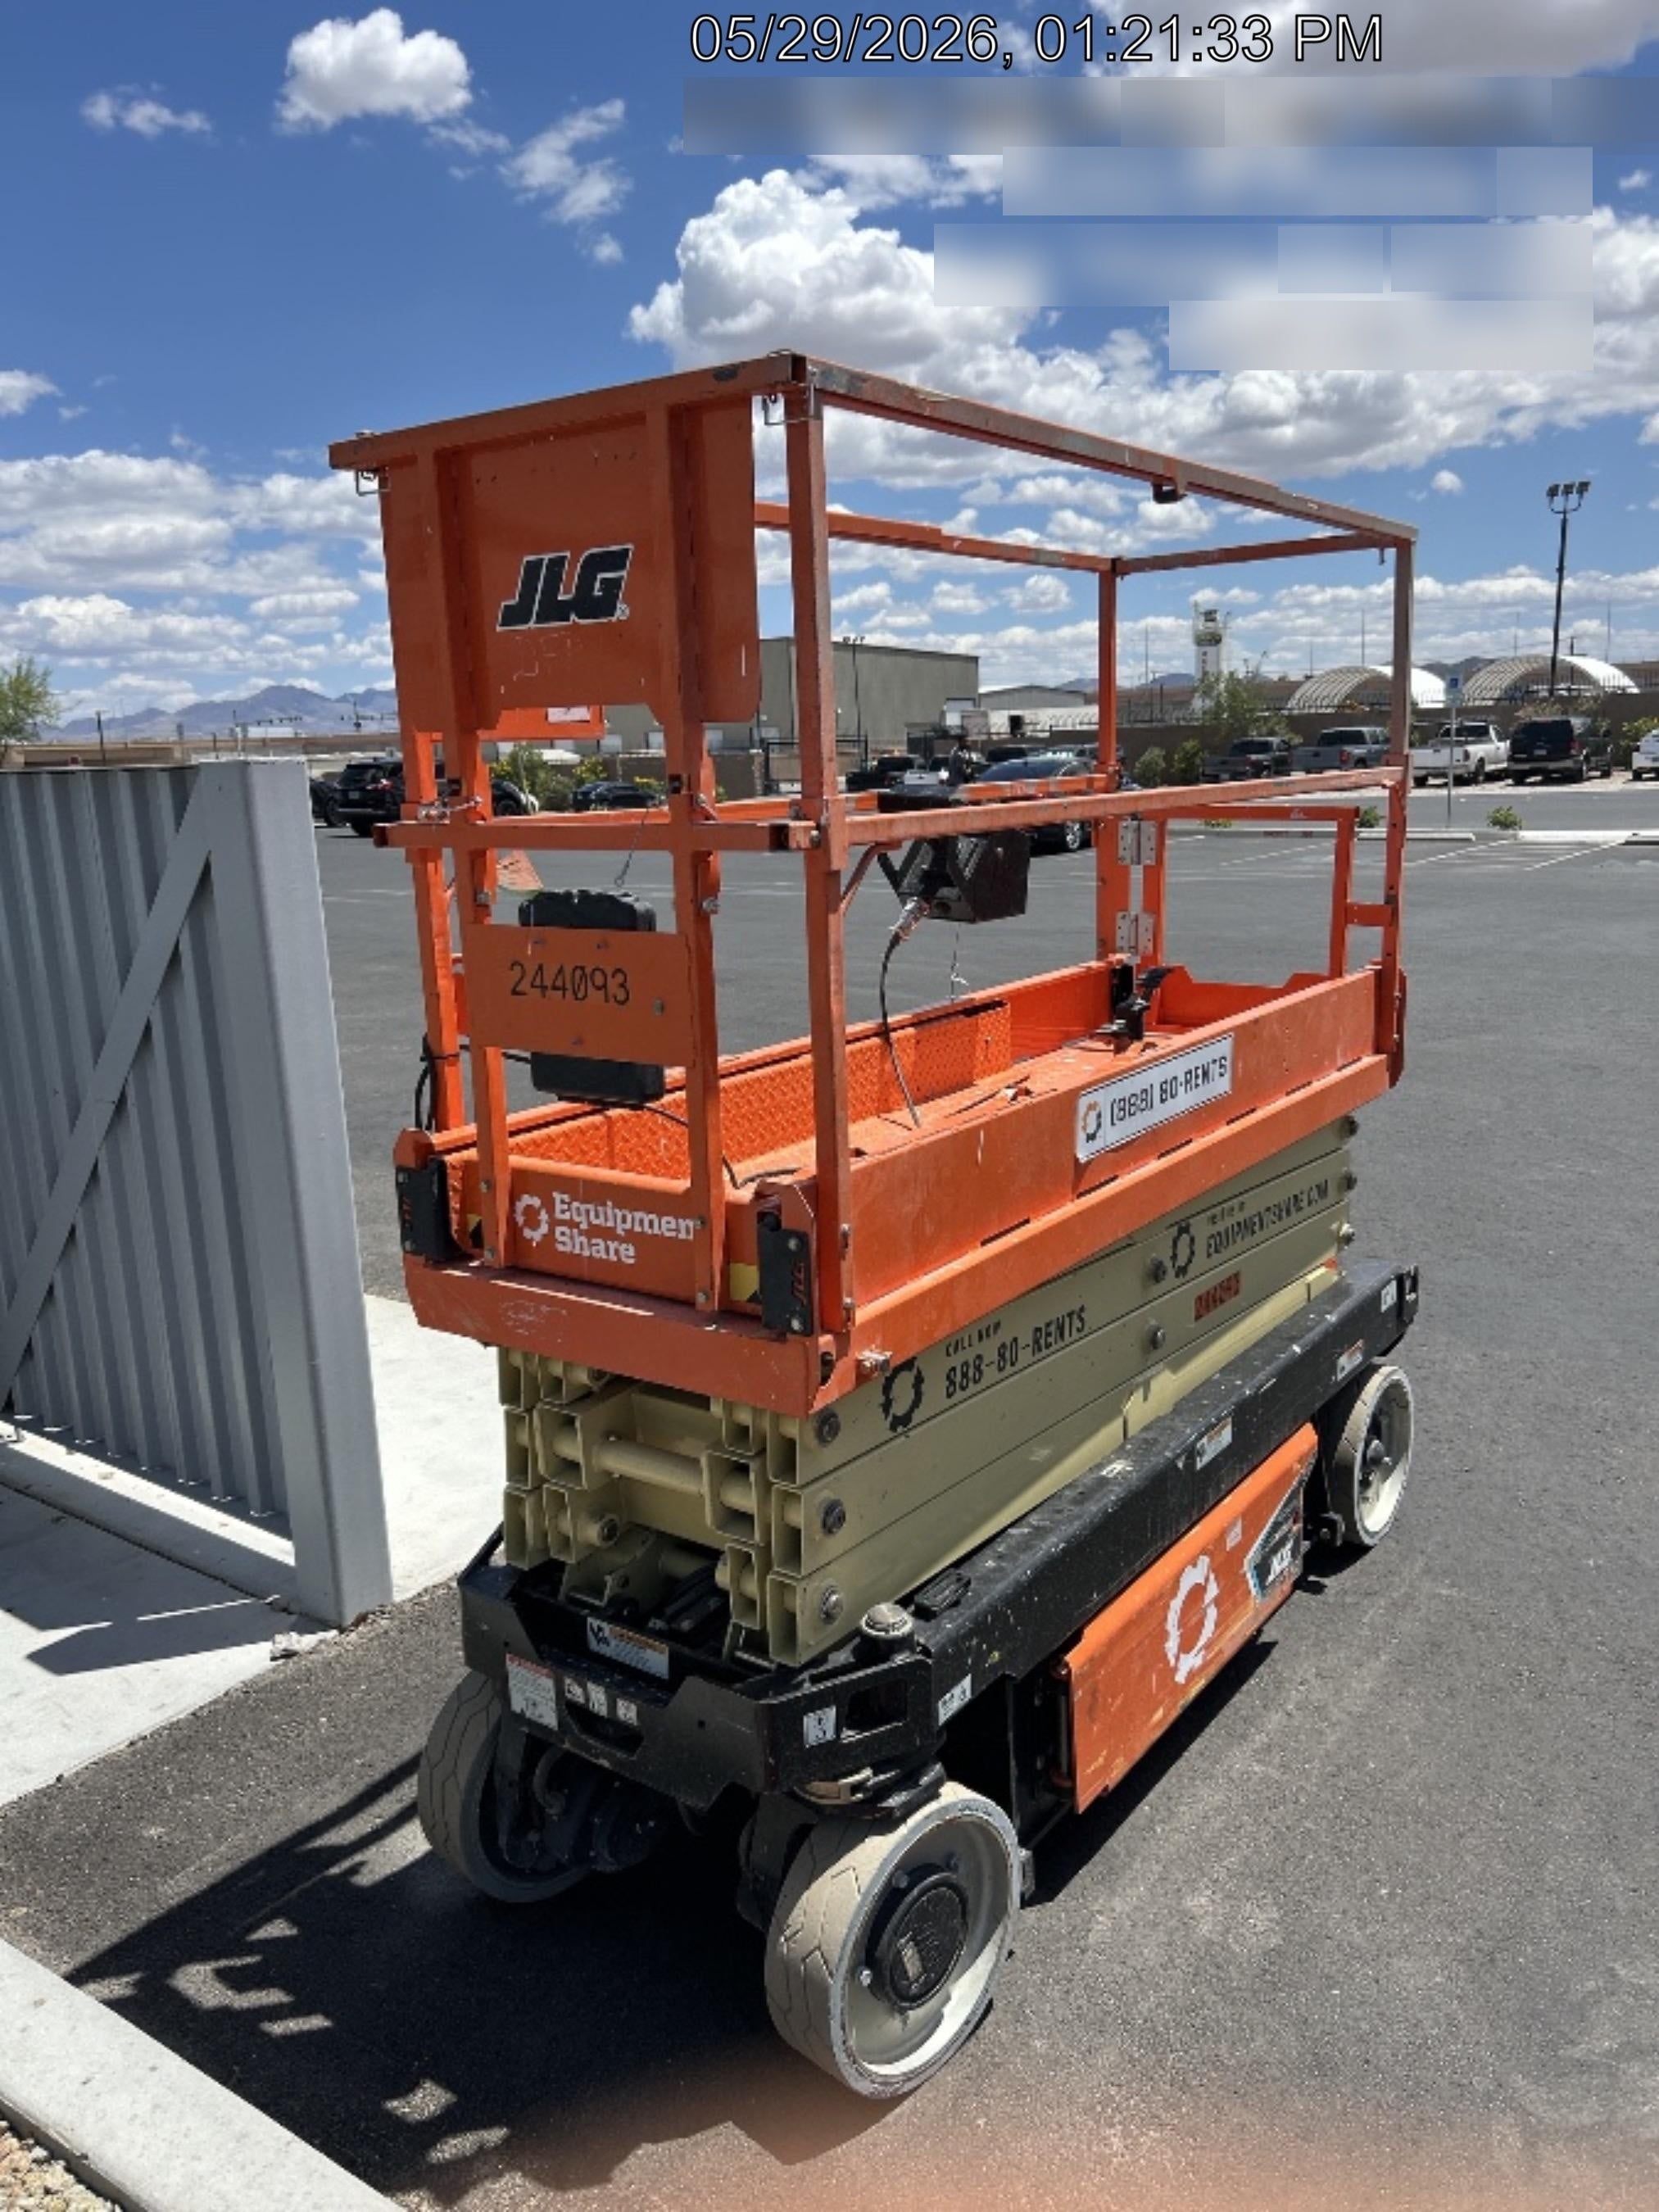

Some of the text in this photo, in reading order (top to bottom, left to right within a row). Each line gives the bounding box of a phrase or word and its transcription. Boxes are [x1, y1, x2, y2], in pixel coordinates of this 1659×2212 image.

[496, 542, 635, 632] JLG
[510, 960, 630, 1006] 244093
[552, 1190, 695, 1240] Equipmen
[555, 1226, 637, 1264] Share
[945, 1303, 1086, 1399] 888-80-RENTS
